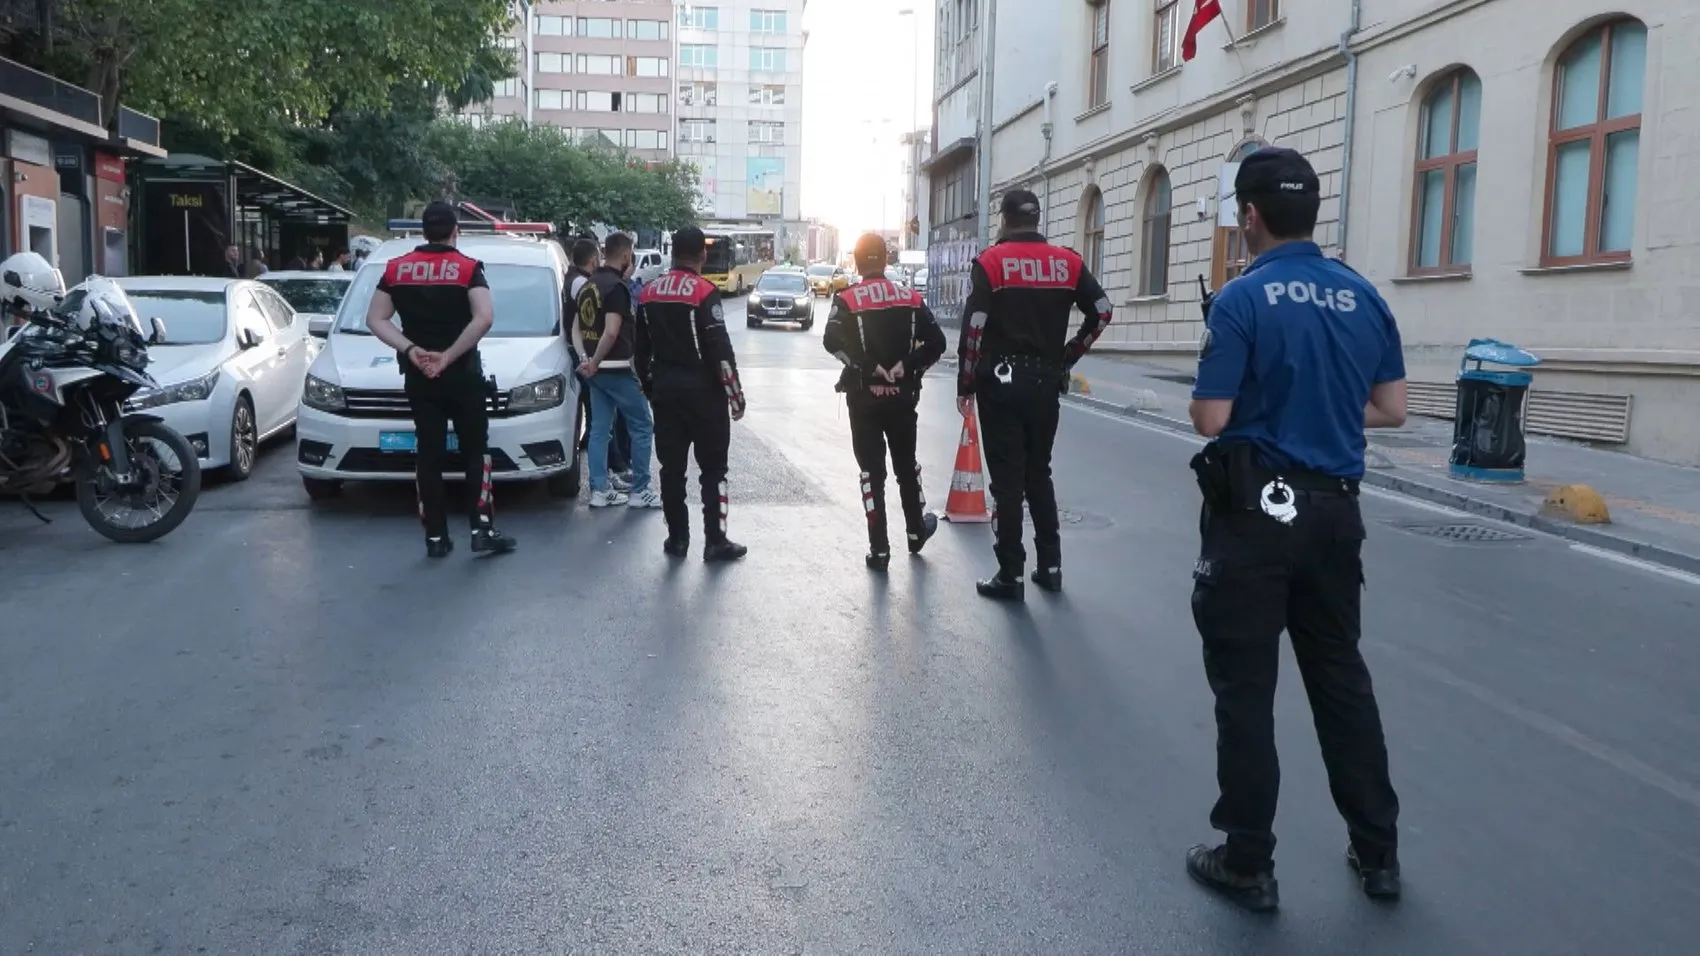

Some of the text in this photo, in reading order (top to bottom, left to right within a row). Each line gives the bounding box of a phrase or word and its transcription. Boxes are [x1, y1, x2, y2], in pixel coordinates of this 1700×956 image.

[168, 194, 202, 207] Taksi
[397, 259, 460, 282] POLİS
[1003, 256, 1069, 283] POLİS
